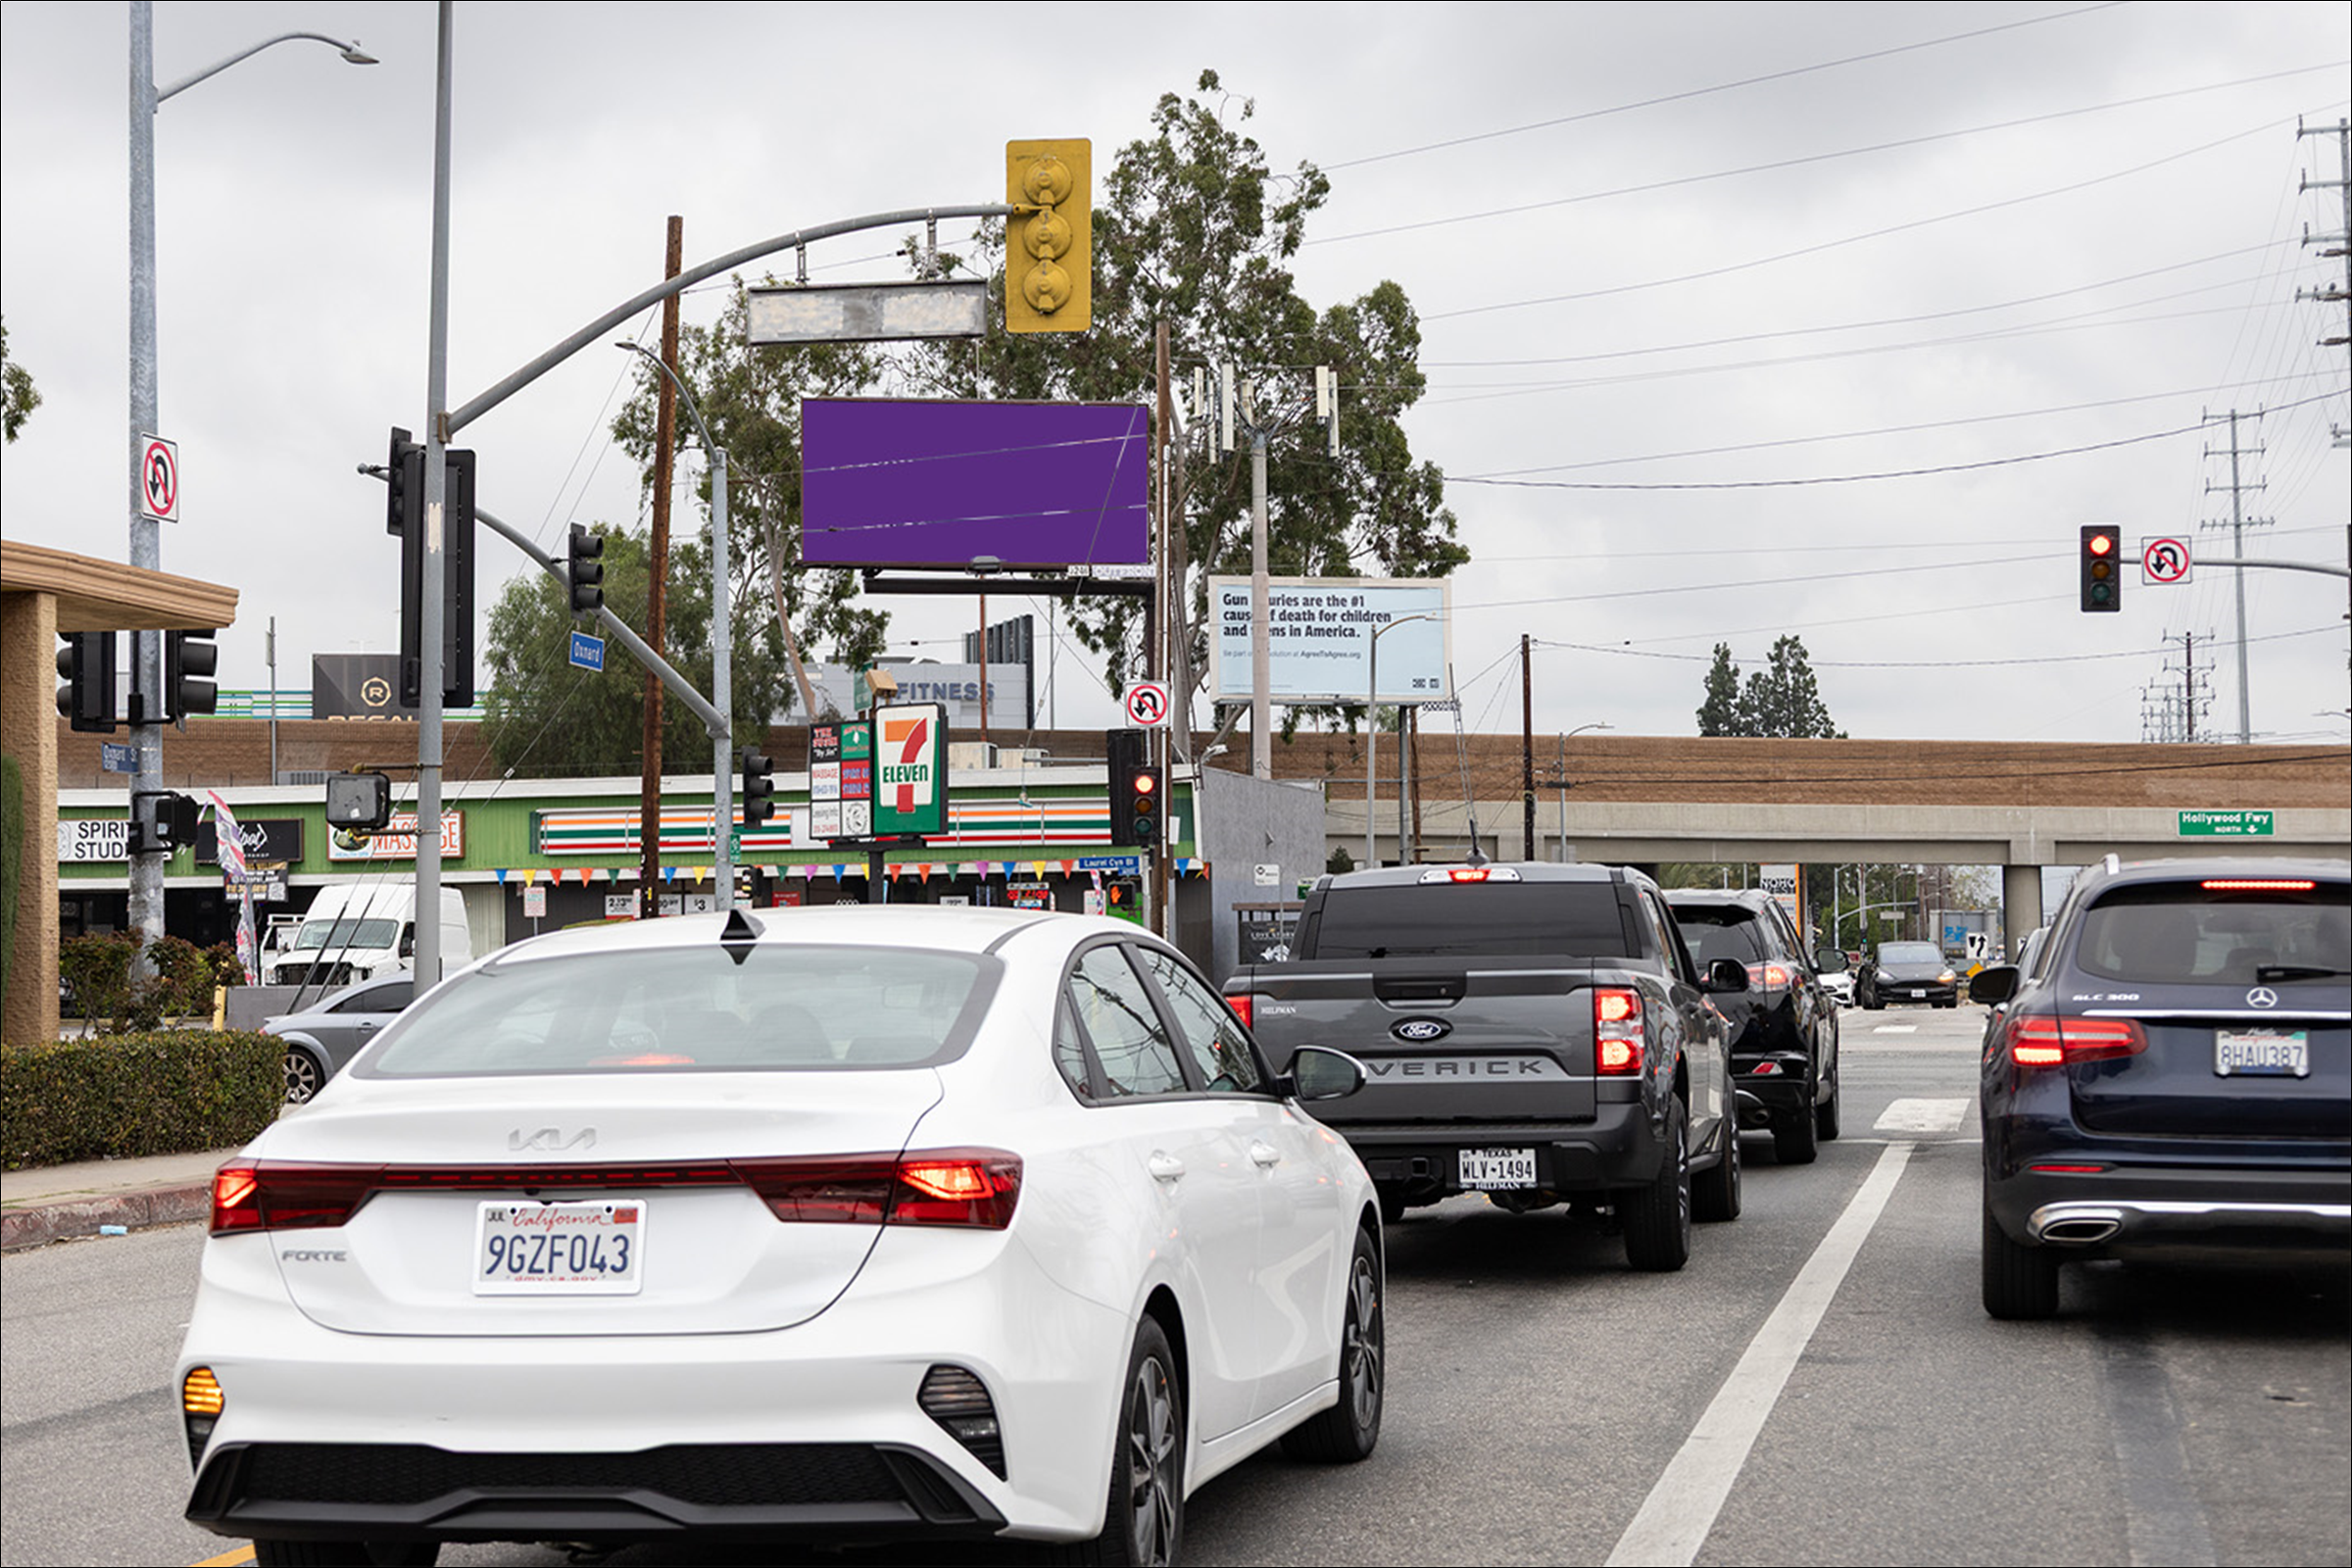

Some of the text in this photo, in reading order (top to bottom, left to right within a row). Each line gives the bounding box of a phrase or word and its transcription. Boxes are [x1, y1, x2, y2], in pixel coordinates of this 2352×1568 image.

[1223, 594, 1249, 607] Gun
[1302, 597, 1323, 607] are
[1326, 596, 1348, 607] the
[1351, 596, 1364, 607] #1
[1223, 610, 1251, 621] caus
[1279, 611, 1315, 621] death
[1319, 611, 1337, 621] for
[1341, 611, 1392, 622] children
[1223, 624, 1248, 637] and
[1290, 624, 1301, 637] in
[1304, 625, 1361, 638] America.
[574, 641, 600, 662] Oxnard
[2182, 812, 2270, 825] Hollywood Fwy
[1406, 1023, 1434, 1036] Ford
[2221, 1046, 2303, 1066] 8HAU387
[1368, 1060, 1543, 1076] VERICK
[513, 1208, 612, 1232] California
[281, 1250, 347, 1262] FORTE
[486, 1235, 629, 1274] 9GZF043
